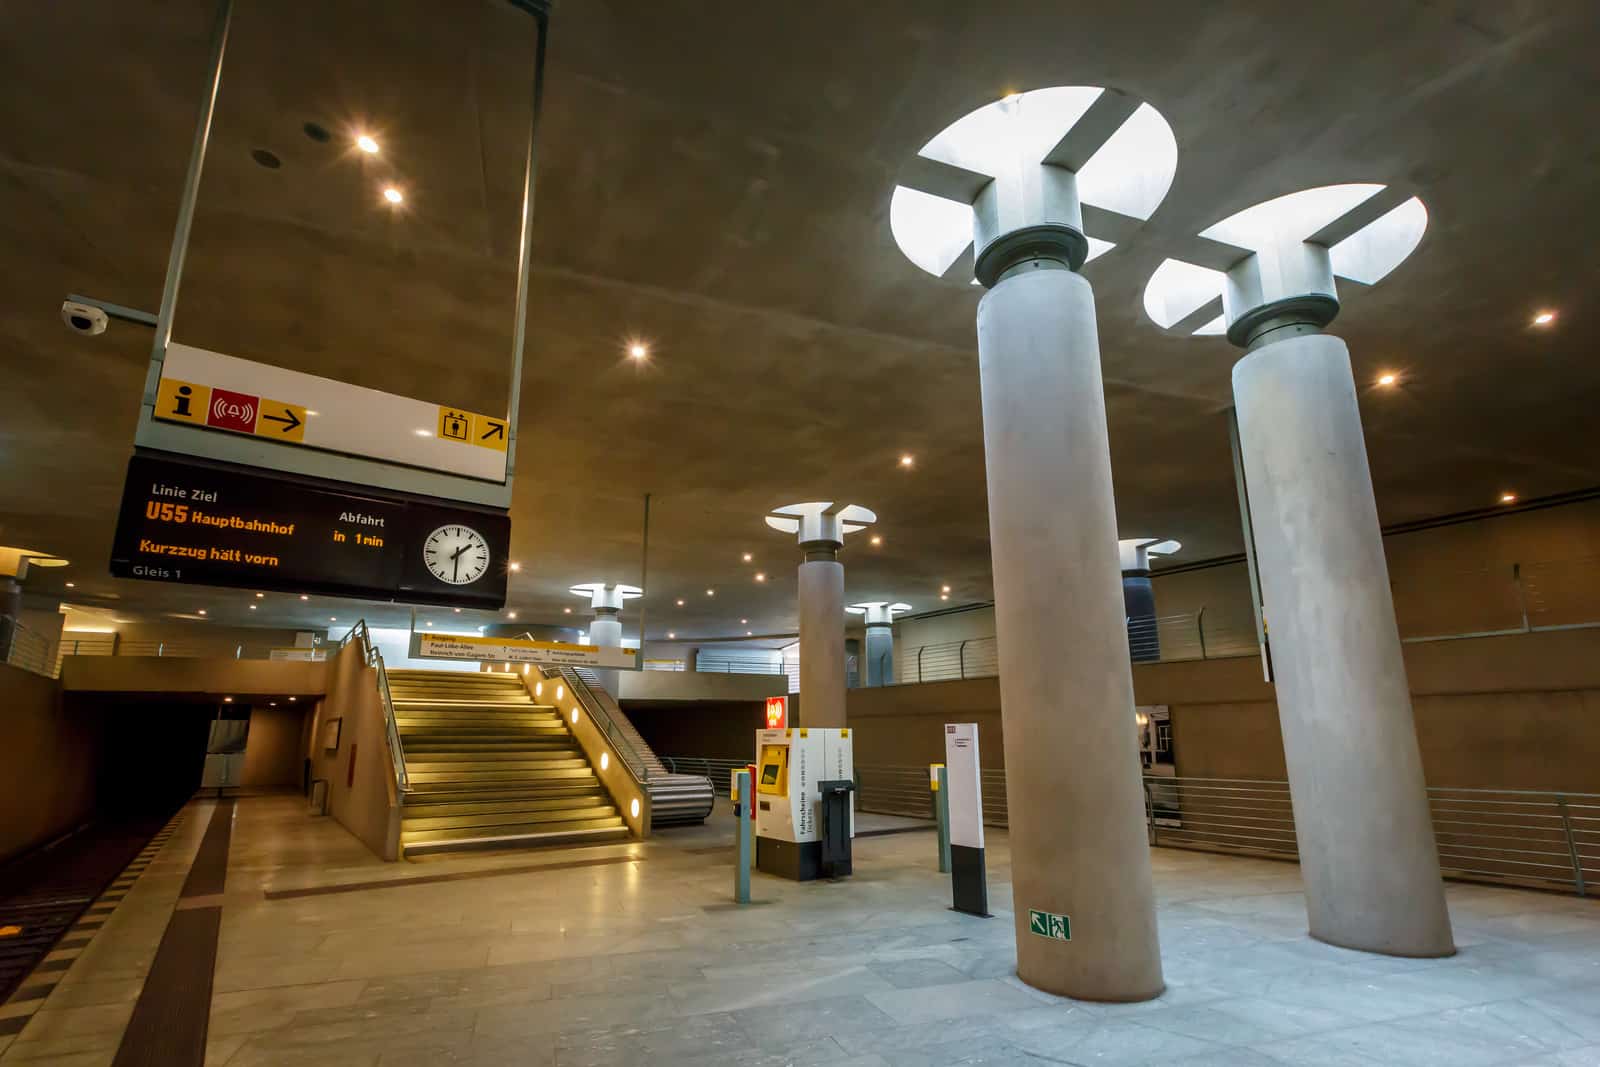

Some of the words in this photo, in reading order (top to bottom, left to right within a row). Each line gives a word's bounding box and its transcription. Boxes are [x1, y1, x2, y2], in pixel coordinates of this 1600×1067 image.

[152, 483, 187, 498] Linie
[191, 489, 218, 503] Ziel
[145, 500, 189, 523] U55
[191, 511, 295, 535] Hauptbahnhof
[339, 512, 385, 528] Abfahrt
[333, 530, 346, 543] in
[139, 539, 207, 560] Kurzzug
[210, 547, 241, 562] hält
[245, 553, 279, 566] vorn
[132, 565, 170, 578] Gleis
[175, 569, 182, 579] 1
